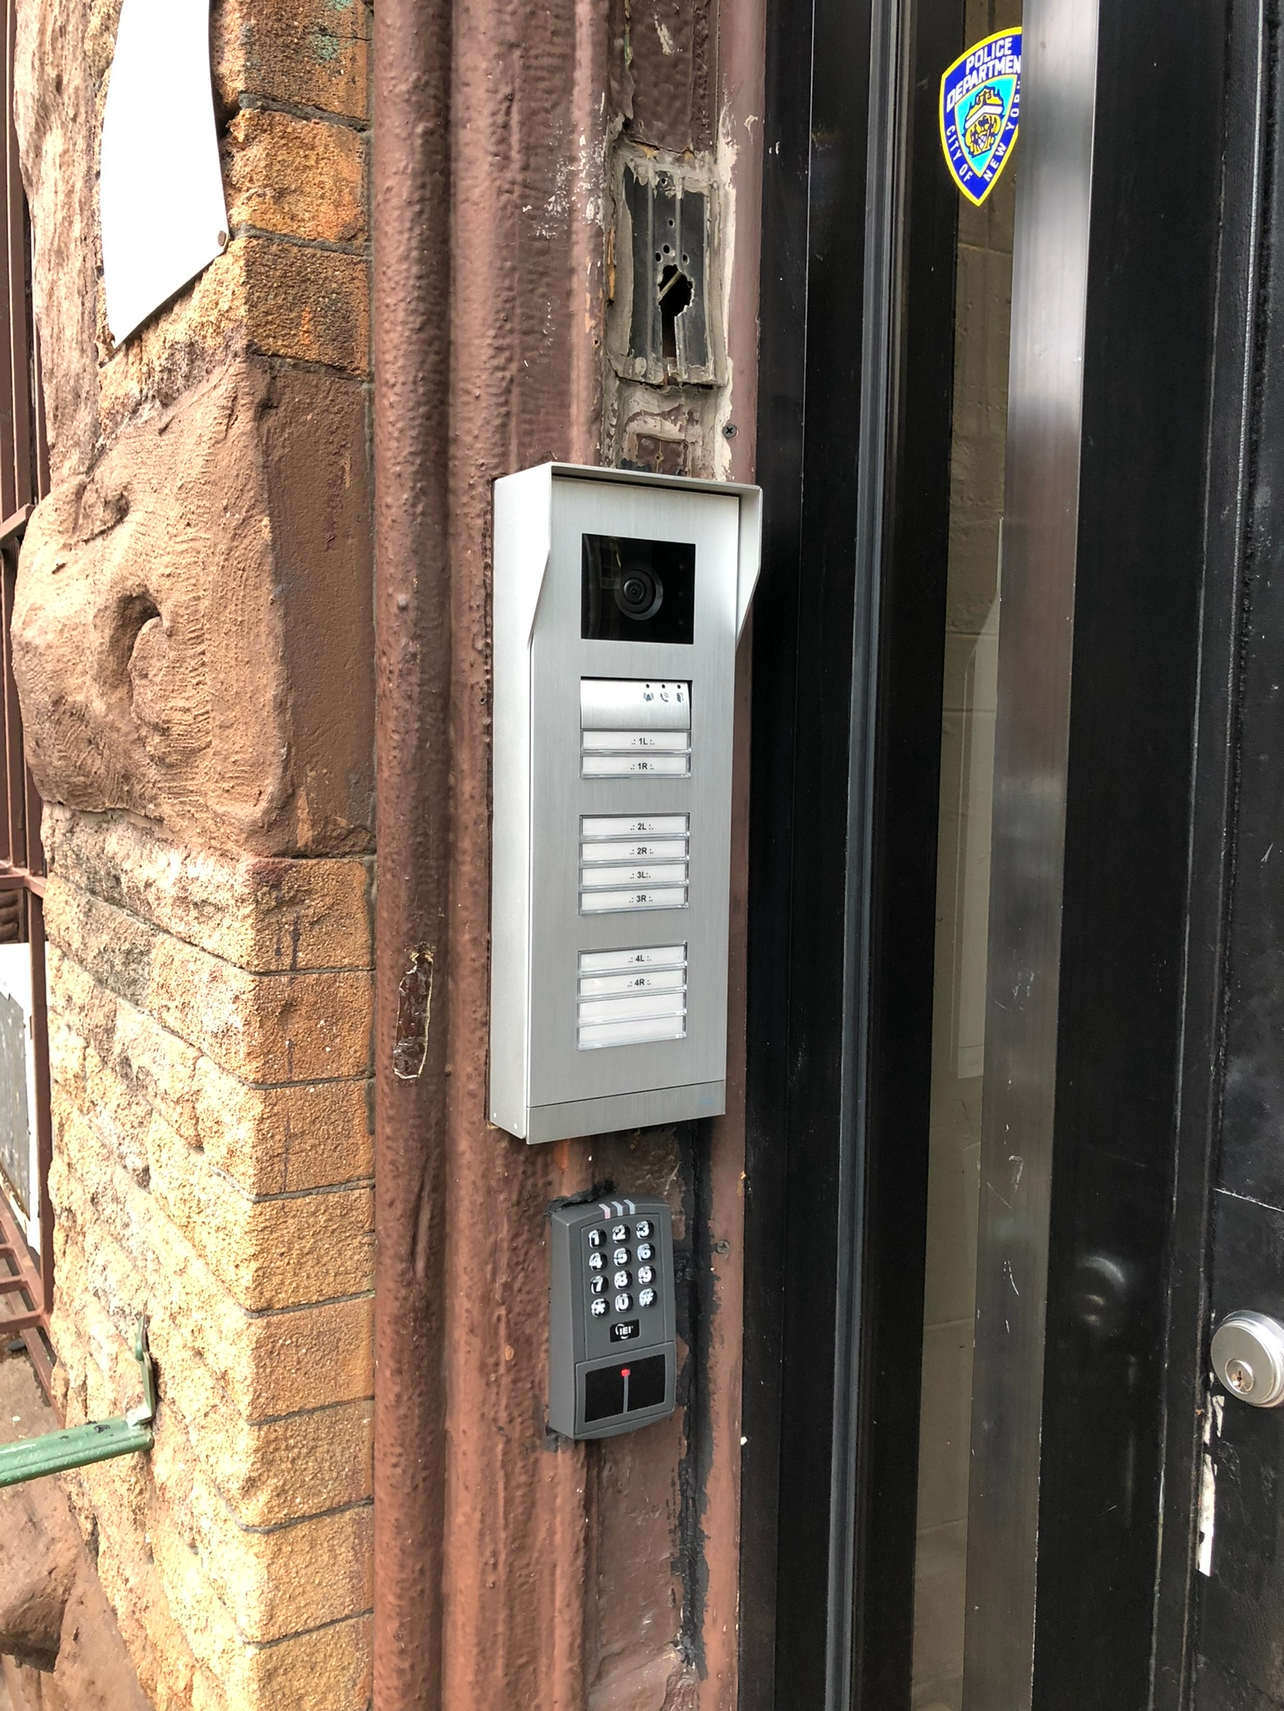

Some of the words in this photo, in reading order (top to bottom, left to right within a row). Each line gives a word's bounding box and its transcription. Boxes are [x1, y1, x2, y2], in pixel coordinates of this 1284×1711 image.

[946, 55, 1021, 113] DEPARTMEN
[966, 37, 1012, 75] POLICE
[946, 125, 962, 161] CITY
[959, 163, 973, 181] OF
[983, 142, 1006, 182] NEW
